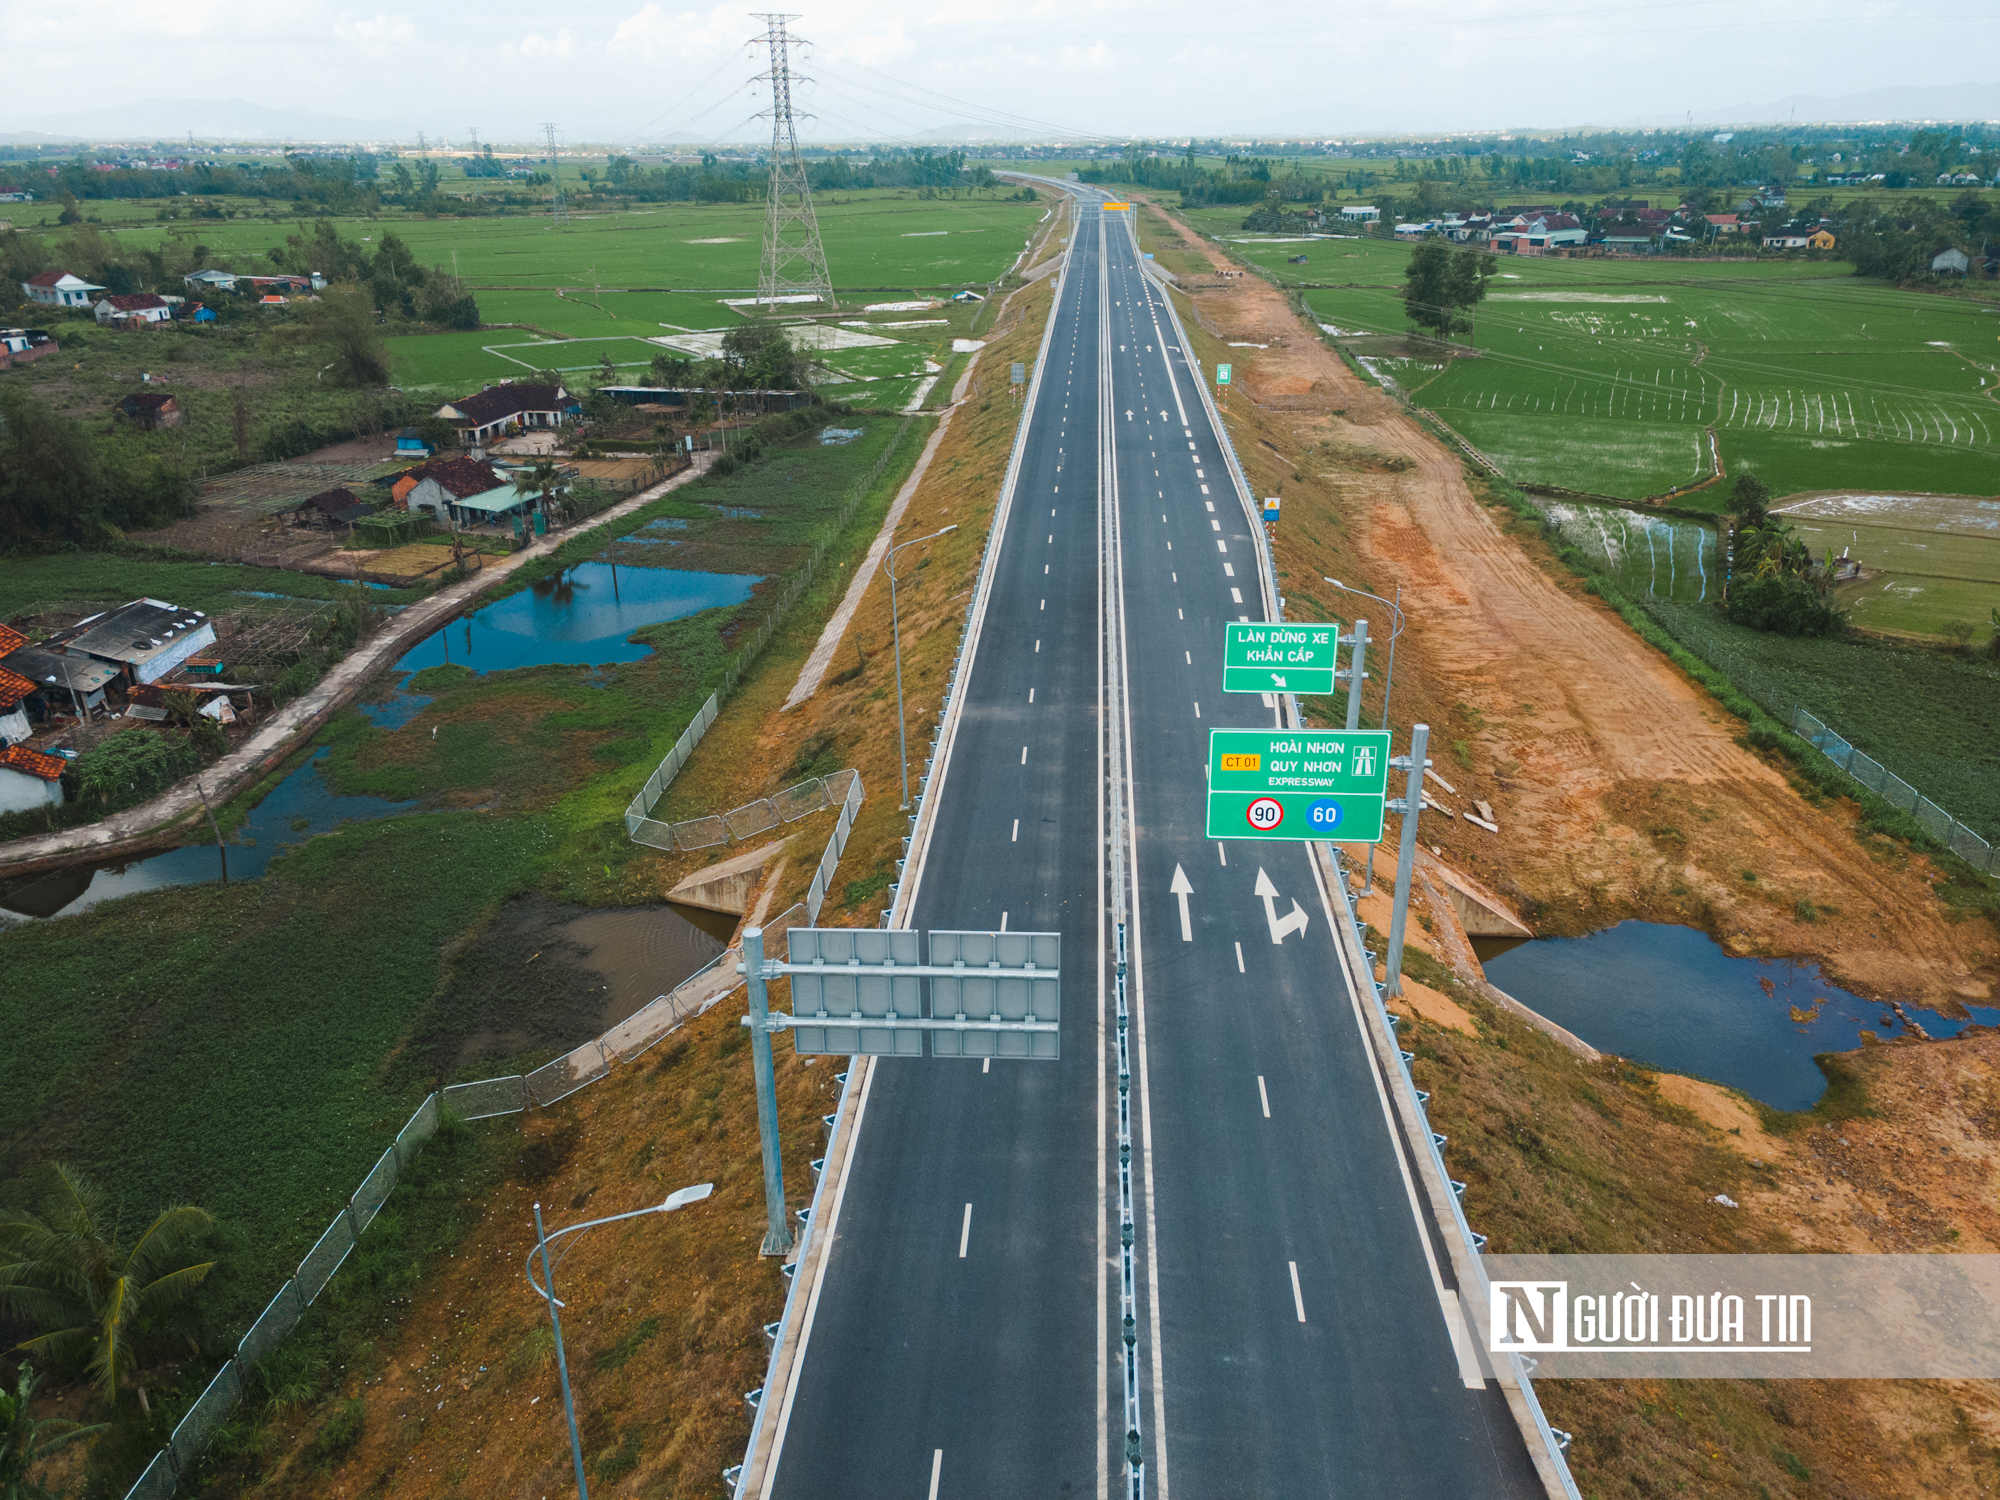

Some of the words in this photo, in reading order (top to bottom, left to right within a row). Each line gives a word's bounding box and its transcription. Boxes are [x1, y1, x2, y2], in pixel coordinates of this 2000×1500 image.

[1238, 628, 1265, 643] LÀN
[1270, 628, 1307, 644] DỪNG
[1312, 632, 1330, 644] XE
[1246, 645, 1283, 662] KHẨN
[1287, 646, 1314, 662] CẤP
[1270, 739, 1302, 753] HOÀI
[1306, 741, 1345, 754] NHƠN
[1226, 757, 1256, 767] CT.01
[1270, 760, 1298, 772] QUY
[1303, 760, 1342, 773] NHƠN
[1268, 777, 1335, 787] EXPRESSWAY
[1254, 806, 1275, 822] 90
[1313, 807, 1336, 823] 60
